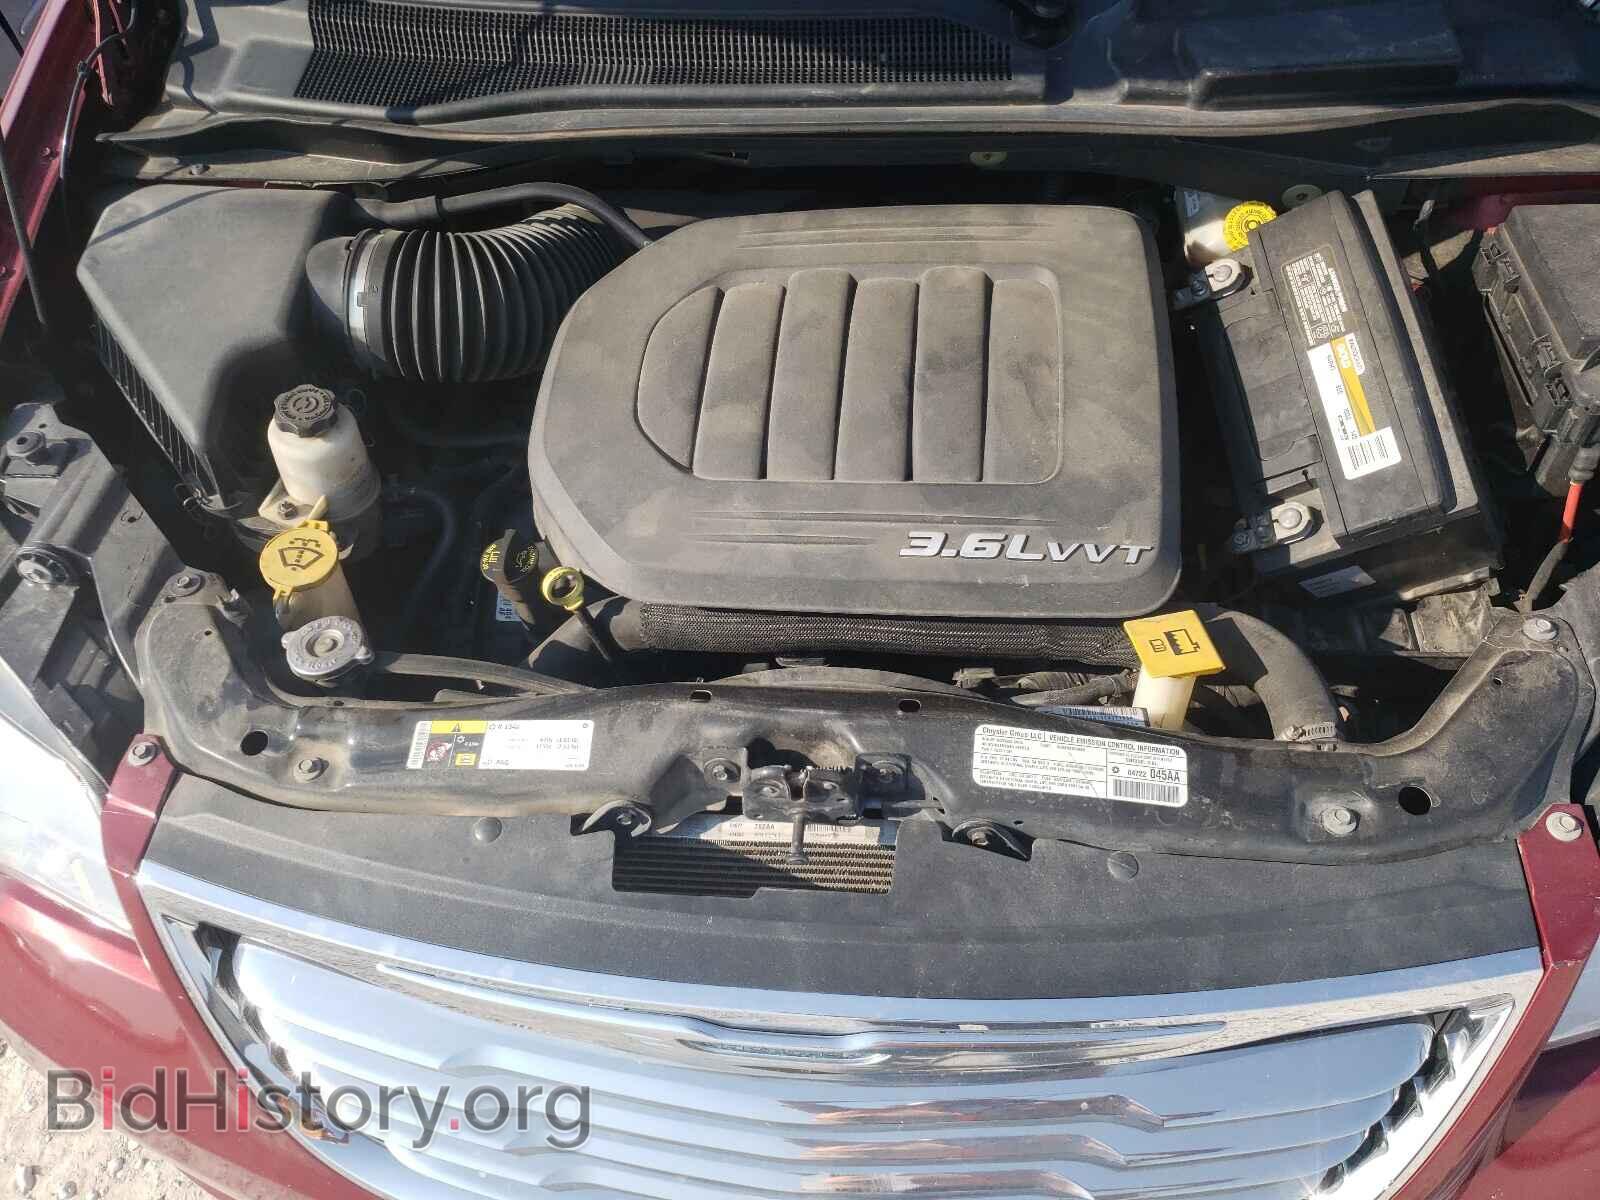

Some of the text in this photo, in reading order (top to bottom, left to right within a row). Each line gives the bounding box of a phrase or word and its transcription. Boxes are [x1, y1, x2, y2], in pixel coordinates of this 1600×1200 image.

[1047, 541, 1153, 565] VVT
[982, 726, 1180, 756] Chrysler Group LLC VEHICLE EMISSION CONTROL INFORMATION
